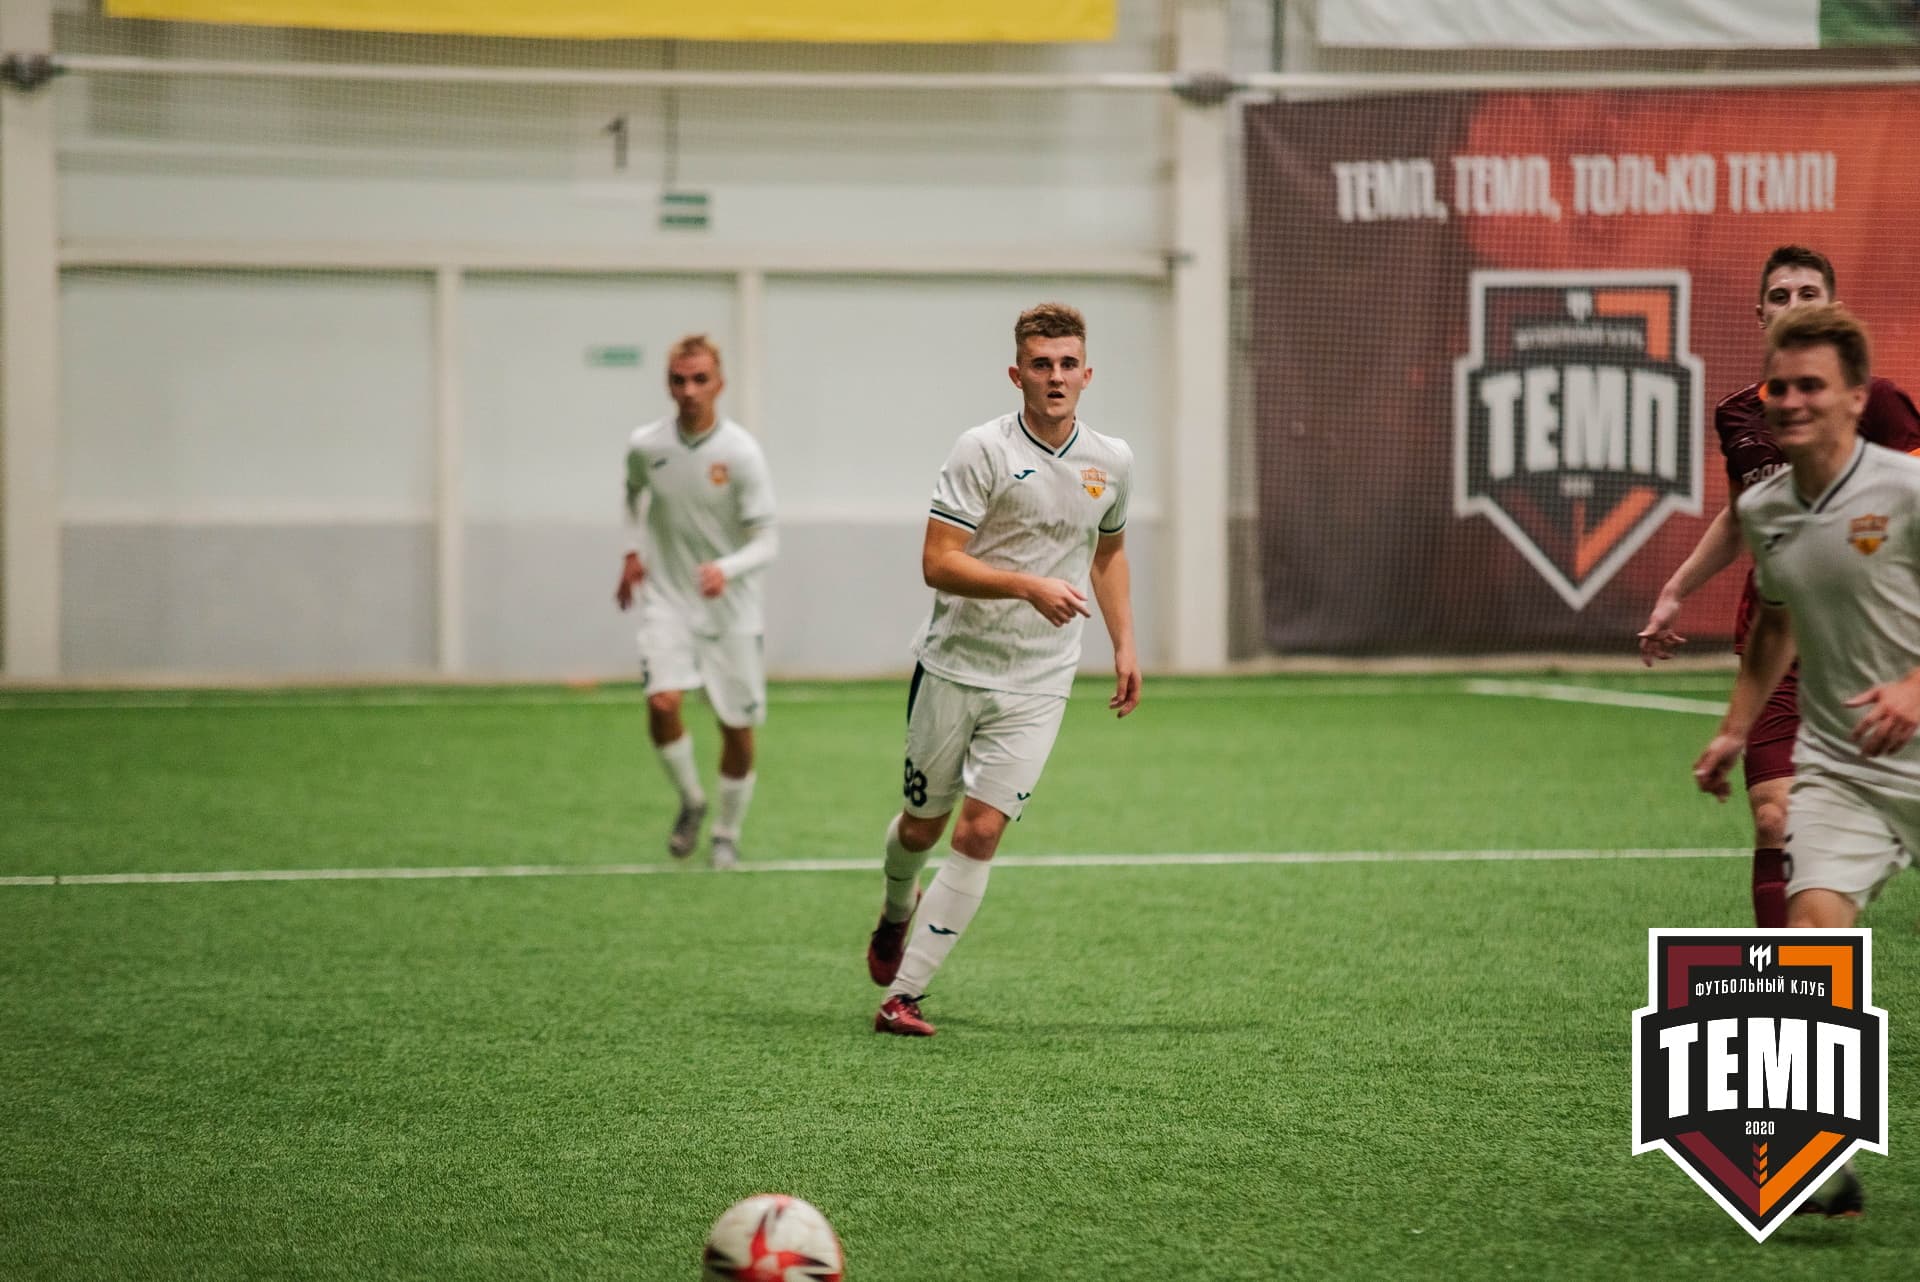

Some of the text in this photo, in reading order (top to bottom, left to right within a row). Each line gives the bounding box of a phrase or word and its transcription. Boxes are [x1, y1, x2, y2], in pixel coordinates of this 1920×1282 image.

[605, 116, 628, 169] 1
[1332, 151, 1837, 224] ТЕМП, ТЕМП, ТОЛЬКО ТЕМП!
[1480, 364, 1679, 481] ТЕМП
